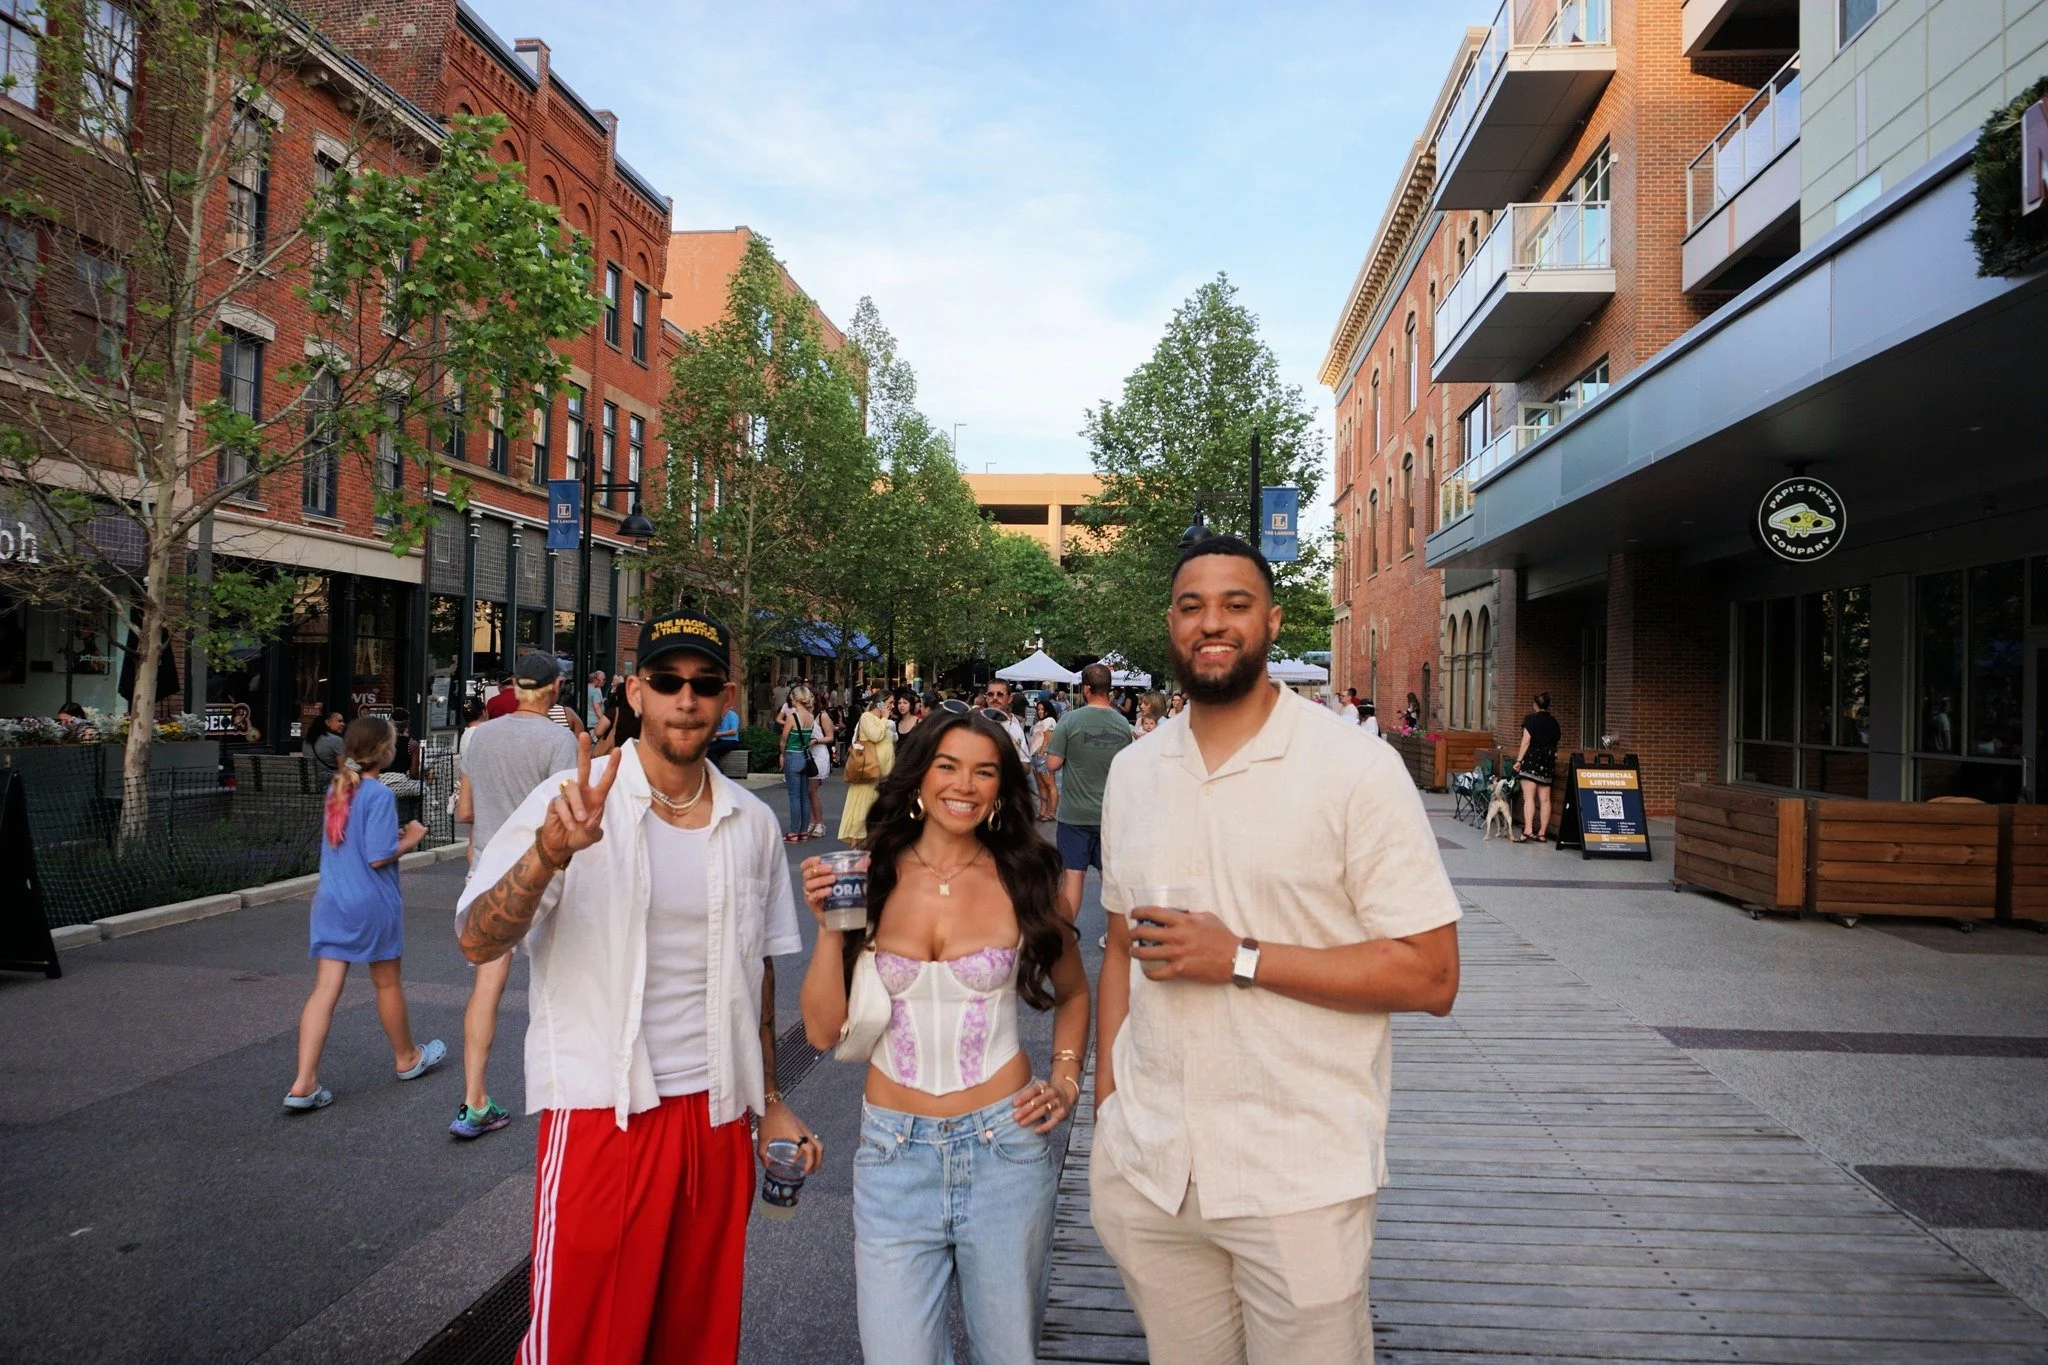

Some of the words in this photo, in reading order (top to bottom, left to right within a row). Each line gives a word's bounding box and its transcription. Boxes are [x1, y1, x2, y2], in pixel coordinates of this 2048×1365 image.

[1769, 484, 1805, 509] PAPI'S
[1807, 485, 1837, 514] PIZZA
[1771, 533, 1831, 555] COMPANY
[653, 619, 673, 631] THE
[675, 618, 707, 631] MAGIC
[651, 631, 660, 641] IN
[660, 626, 681, 636] THE
[350, 693, 377, 704] VI'S
[1580, 771, 1633, 779] COMMERCIAL
